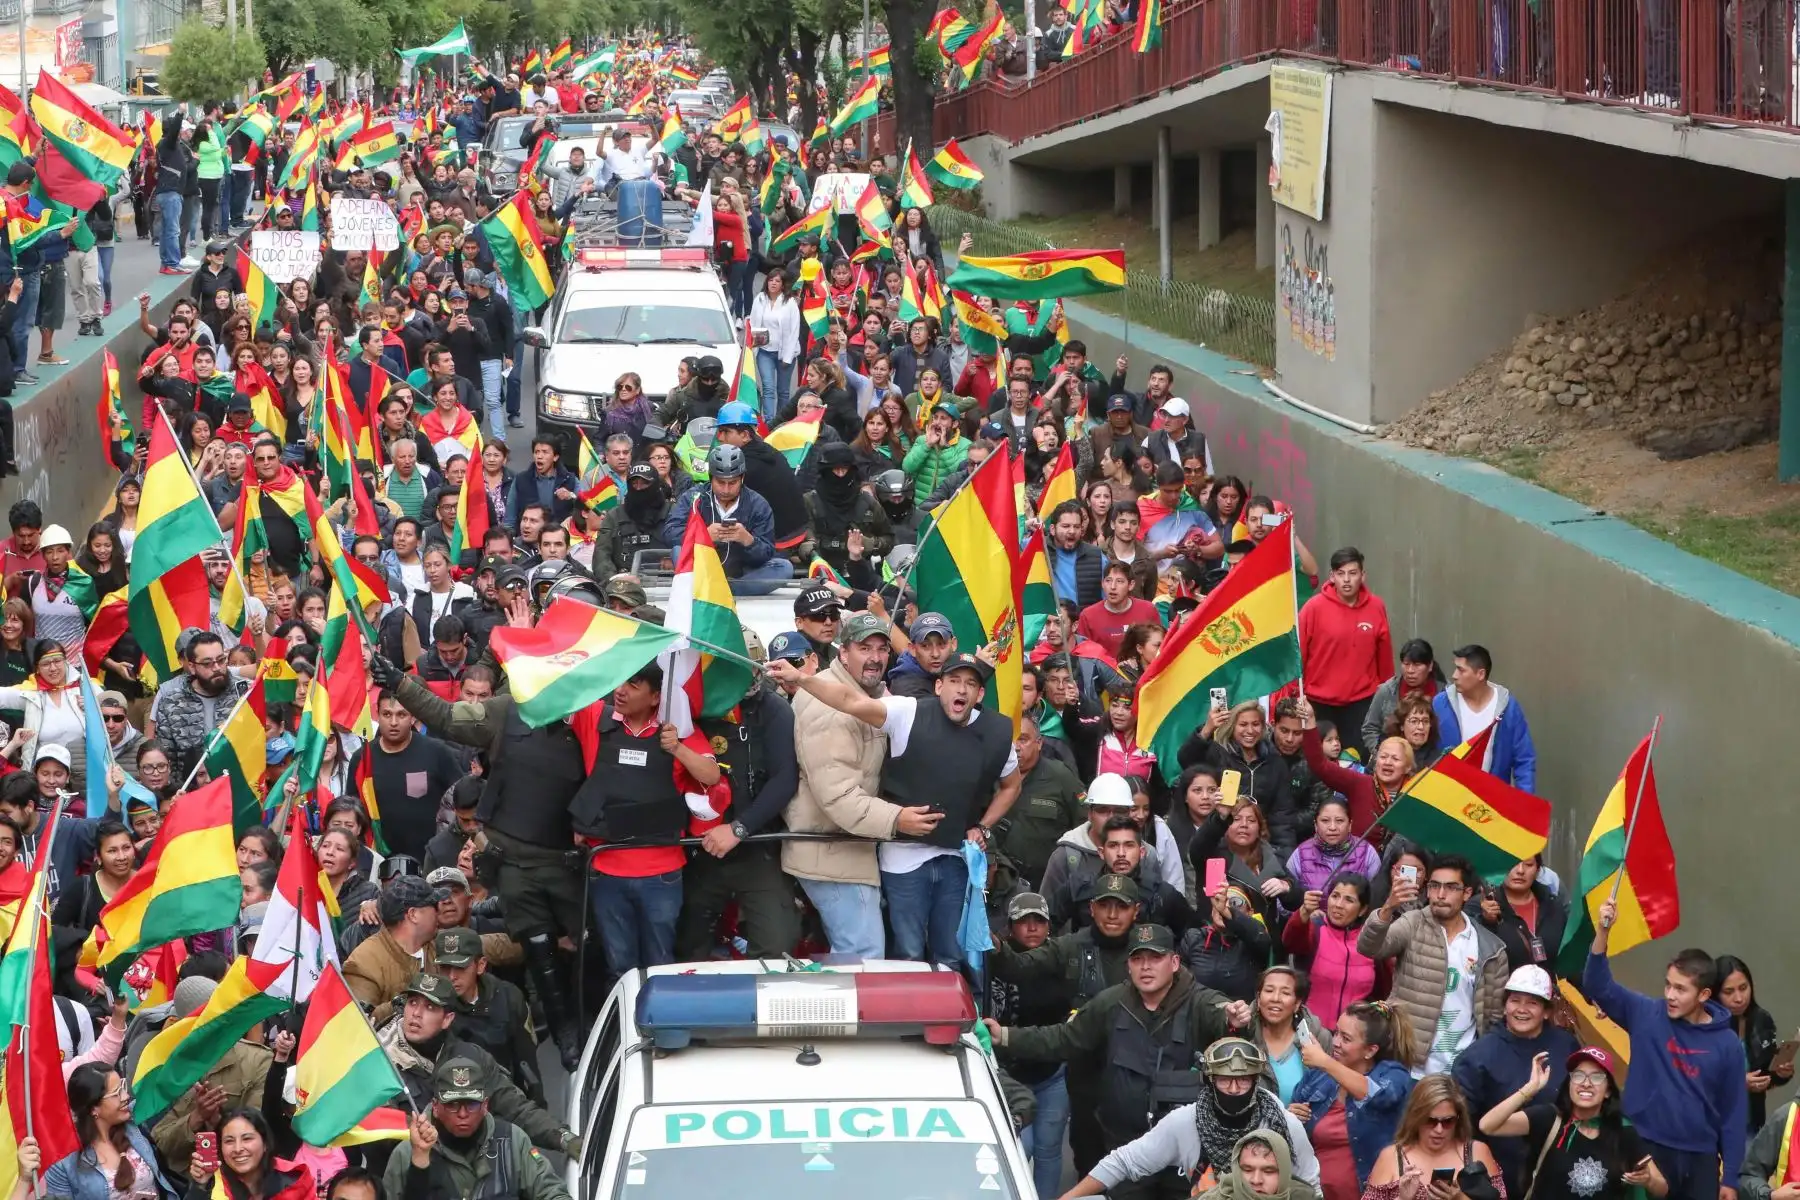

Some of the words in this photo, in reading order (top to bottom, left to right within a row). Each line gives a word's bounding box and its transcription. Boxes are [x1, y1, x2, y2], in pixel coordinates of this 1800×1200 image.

[337, 199, 385, 216] ADELAN
[271, 231, 303, 248] DIOS
[254, 248, 286, 262] TODO
[629, 464, 651, 475] UTOP
[665, 1107, 966, 1144] POLICIA
